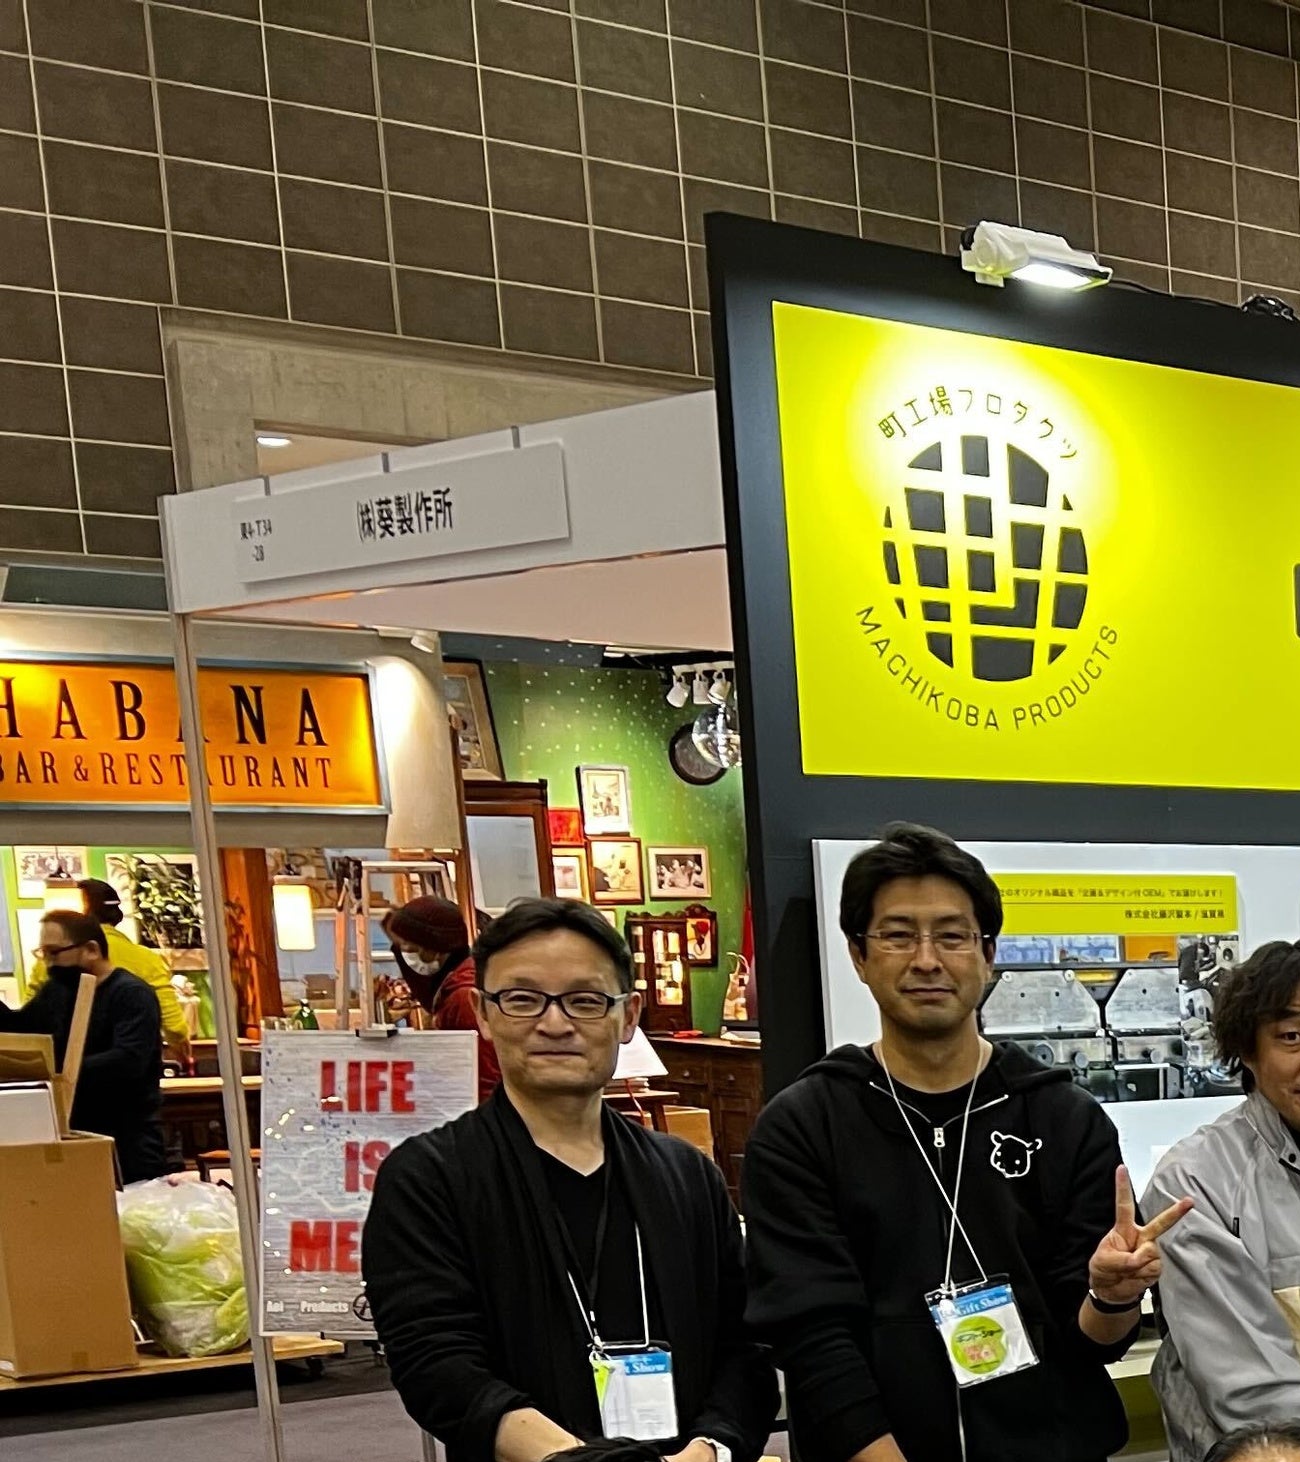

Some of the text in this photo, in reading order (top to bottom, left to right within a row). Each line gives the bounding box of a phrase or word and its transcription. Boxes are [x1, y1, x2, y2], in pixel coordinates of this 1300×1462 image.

[855, 605, 1121, 731] MACHIKOBA PRODUCTS
[0, 751, 59, 785] AR
[74, 755, 90, 782] &
[320, 1060, 416, 1112] LIFE
[290, 1221, 363, 1273] ME
